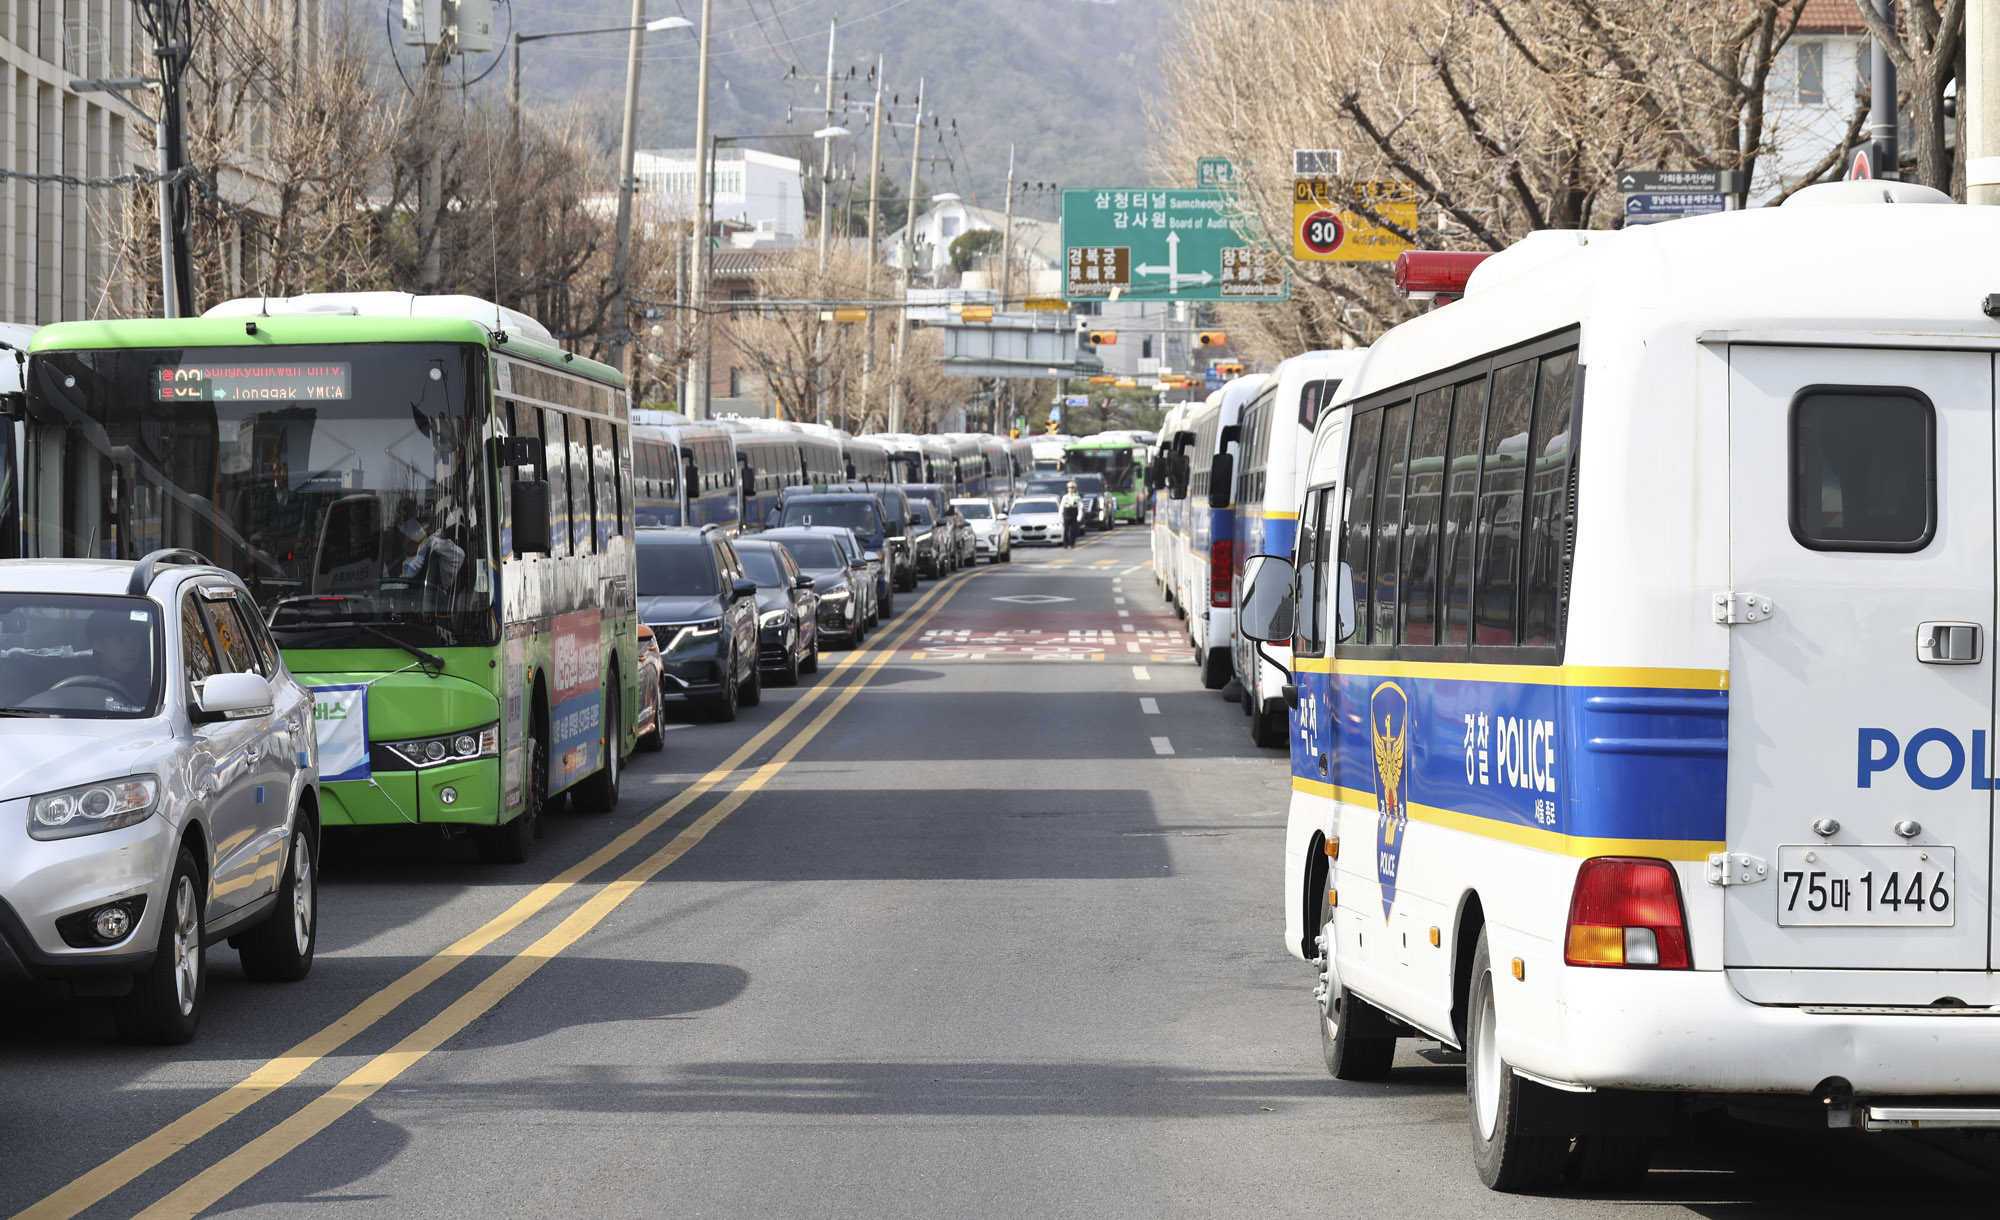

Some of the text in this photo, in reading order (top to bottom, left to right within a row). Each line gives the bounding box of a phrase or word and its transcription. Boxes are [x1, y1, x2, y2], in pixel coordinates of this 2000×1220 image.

[1095, 192, 1167, 209] 삼청터널
[1170, 197, 1224, 211] Samcheong
[1113, 211, 1167, 229] 감사원
[1169, 217, 1193, 229] Board
[1194, 217, 1204, 229] of
[1207, 217, 1228, 229] Audit
[1311, 221, 1335, 243] 30
[1070, 248, 1116, 265] 경복궁
[307, 385, 343, 398] YMCA
[1300, 697, 1318, 757] 작전
[1463, 711, 1556, 793] 경찰 POLICE
[1380, 851, 1395, 878] POLICE
